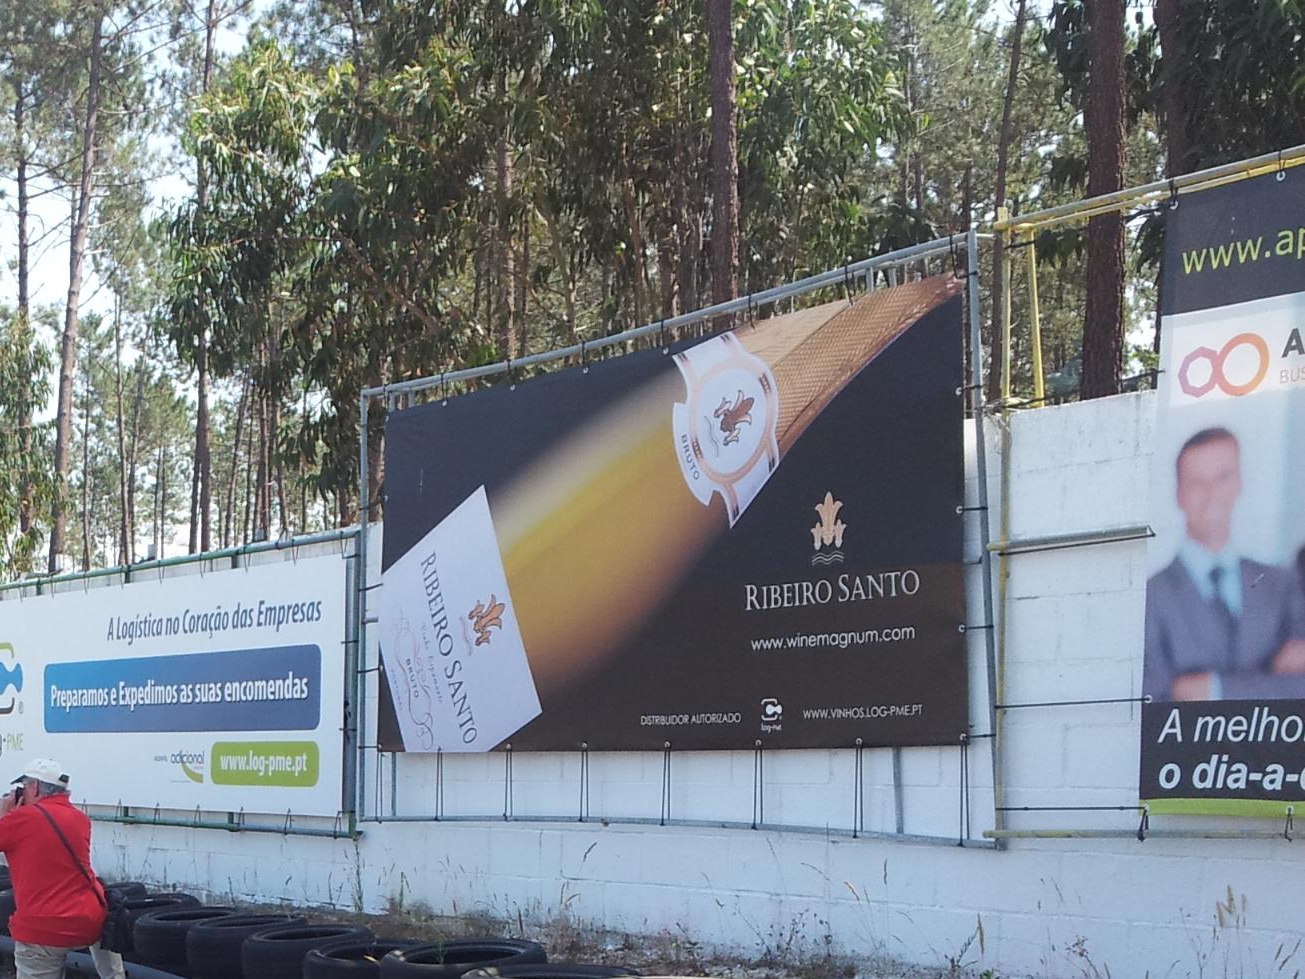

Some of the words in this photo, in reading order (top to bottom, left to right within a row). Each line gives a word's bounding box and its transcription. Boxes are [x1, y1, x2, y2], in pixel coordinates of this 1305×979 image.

[681, 434, 700, 480] BRUTO
[745, 579, 833, 611] RIBEIRO
[838, 569, 920, 602] SANTO
[107, 617, 114, 641] A
[116, 611, 162, 645] Logística
[165, 617, 180, 636] no
[182, 605, 229, 639] Coração
[232, 602, 254, 630] das
[256, 600, 322, 632] Empresas
[751, 627, 915, 650] www.winemagnum.com
[421, 551, 453, 656] RIBEIRO
[444, 660, 477, 744] SANTO
[51, 684, 109, 712] Preparamos
[110, 688, 117, 705] e
[119, 680, 178, 711] Expedimos
[180, 683, 193, 704] as
[195, 682, 223, 703] suas
[224, 671, 308, 701] encomendas
[405, 658, 419, 698] BRUTO
[640, 714, 690, 725] DISTRIBUIDOR
[691, 712, 742, 724] AUTORIZADO
[802, 704, 923, 719] WWW.VINHOS.LOG-PME.PT
[1158, 708, 1182, 743] A
[1193, 706, 1305, 742] melho
[220, 750, 308, 776] www.log-pme.pt
[1158, 762, 1181, 789] o
[1193, 754, 1305, 790] dia-a-
